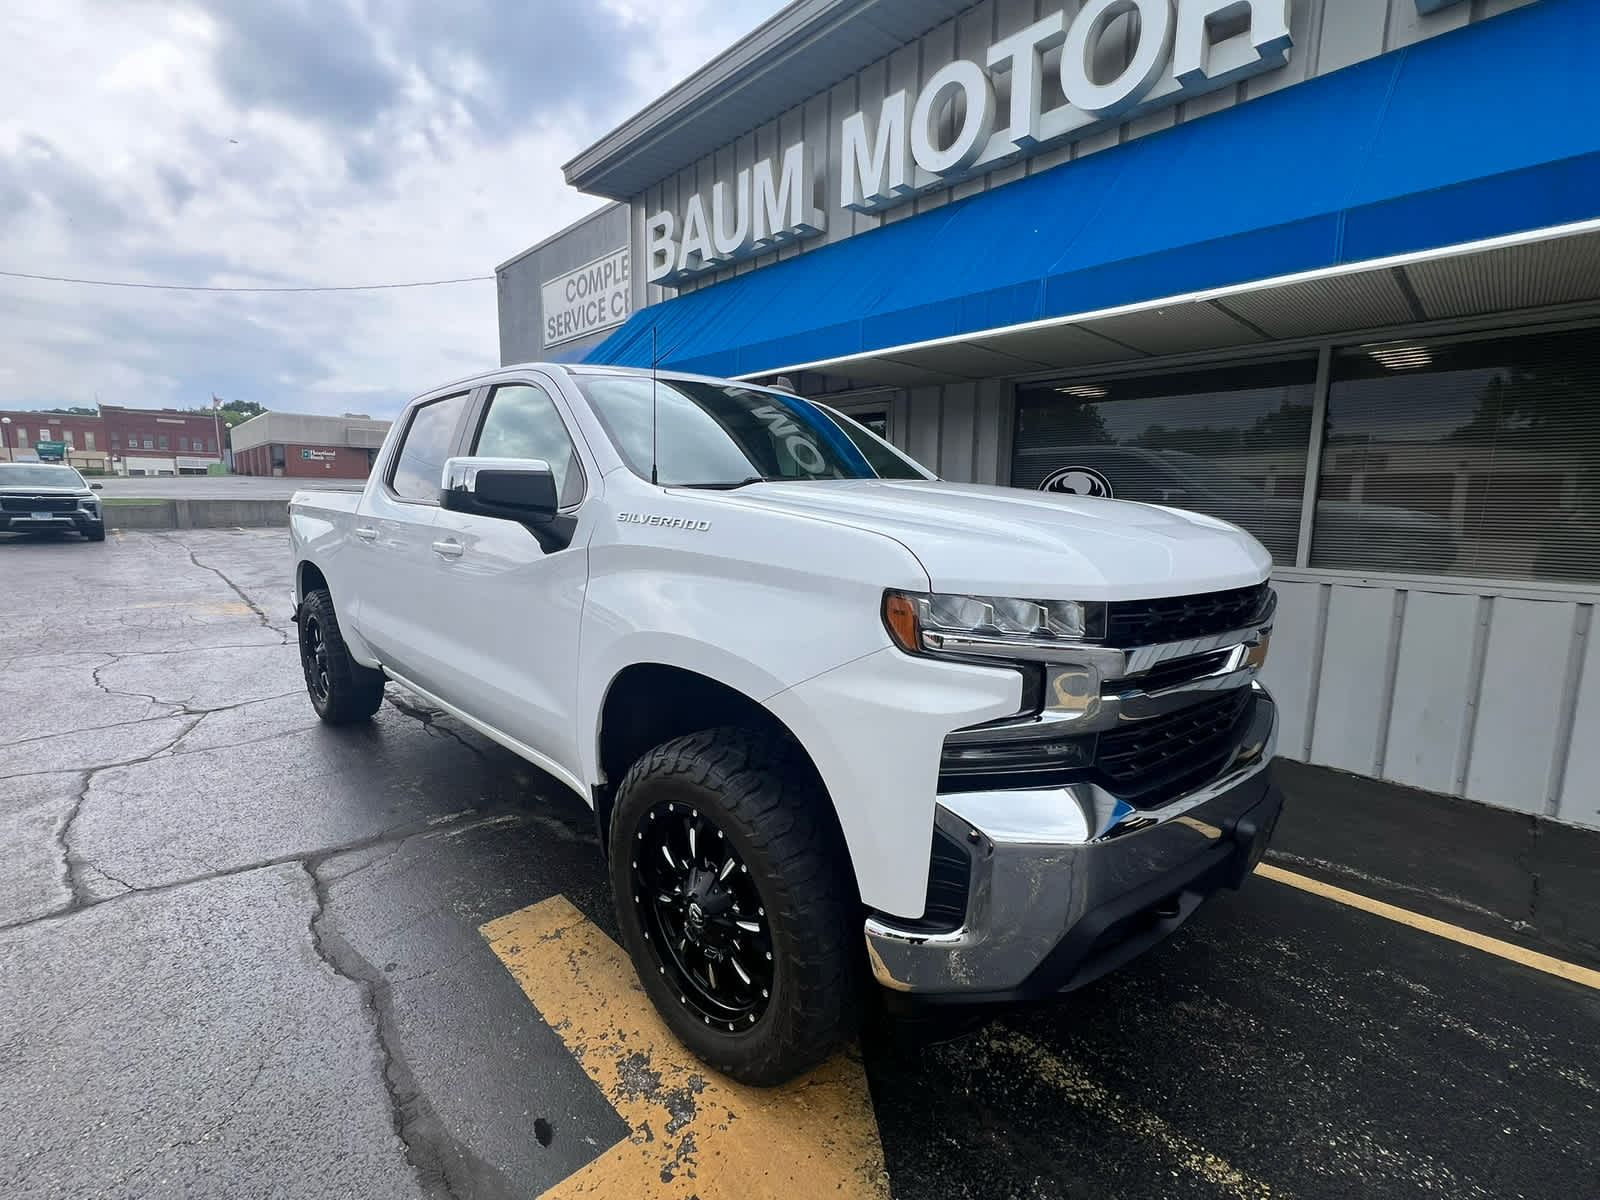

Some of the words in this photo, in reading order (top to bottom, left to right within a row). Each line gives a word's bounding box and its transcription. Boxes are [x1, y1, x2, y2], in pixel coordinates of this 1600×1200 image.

[647, 141, 804, 283] BAUM
[548, 297, 607, 339] SERVICE
[617, 511, 713, 533] SILVERADO
